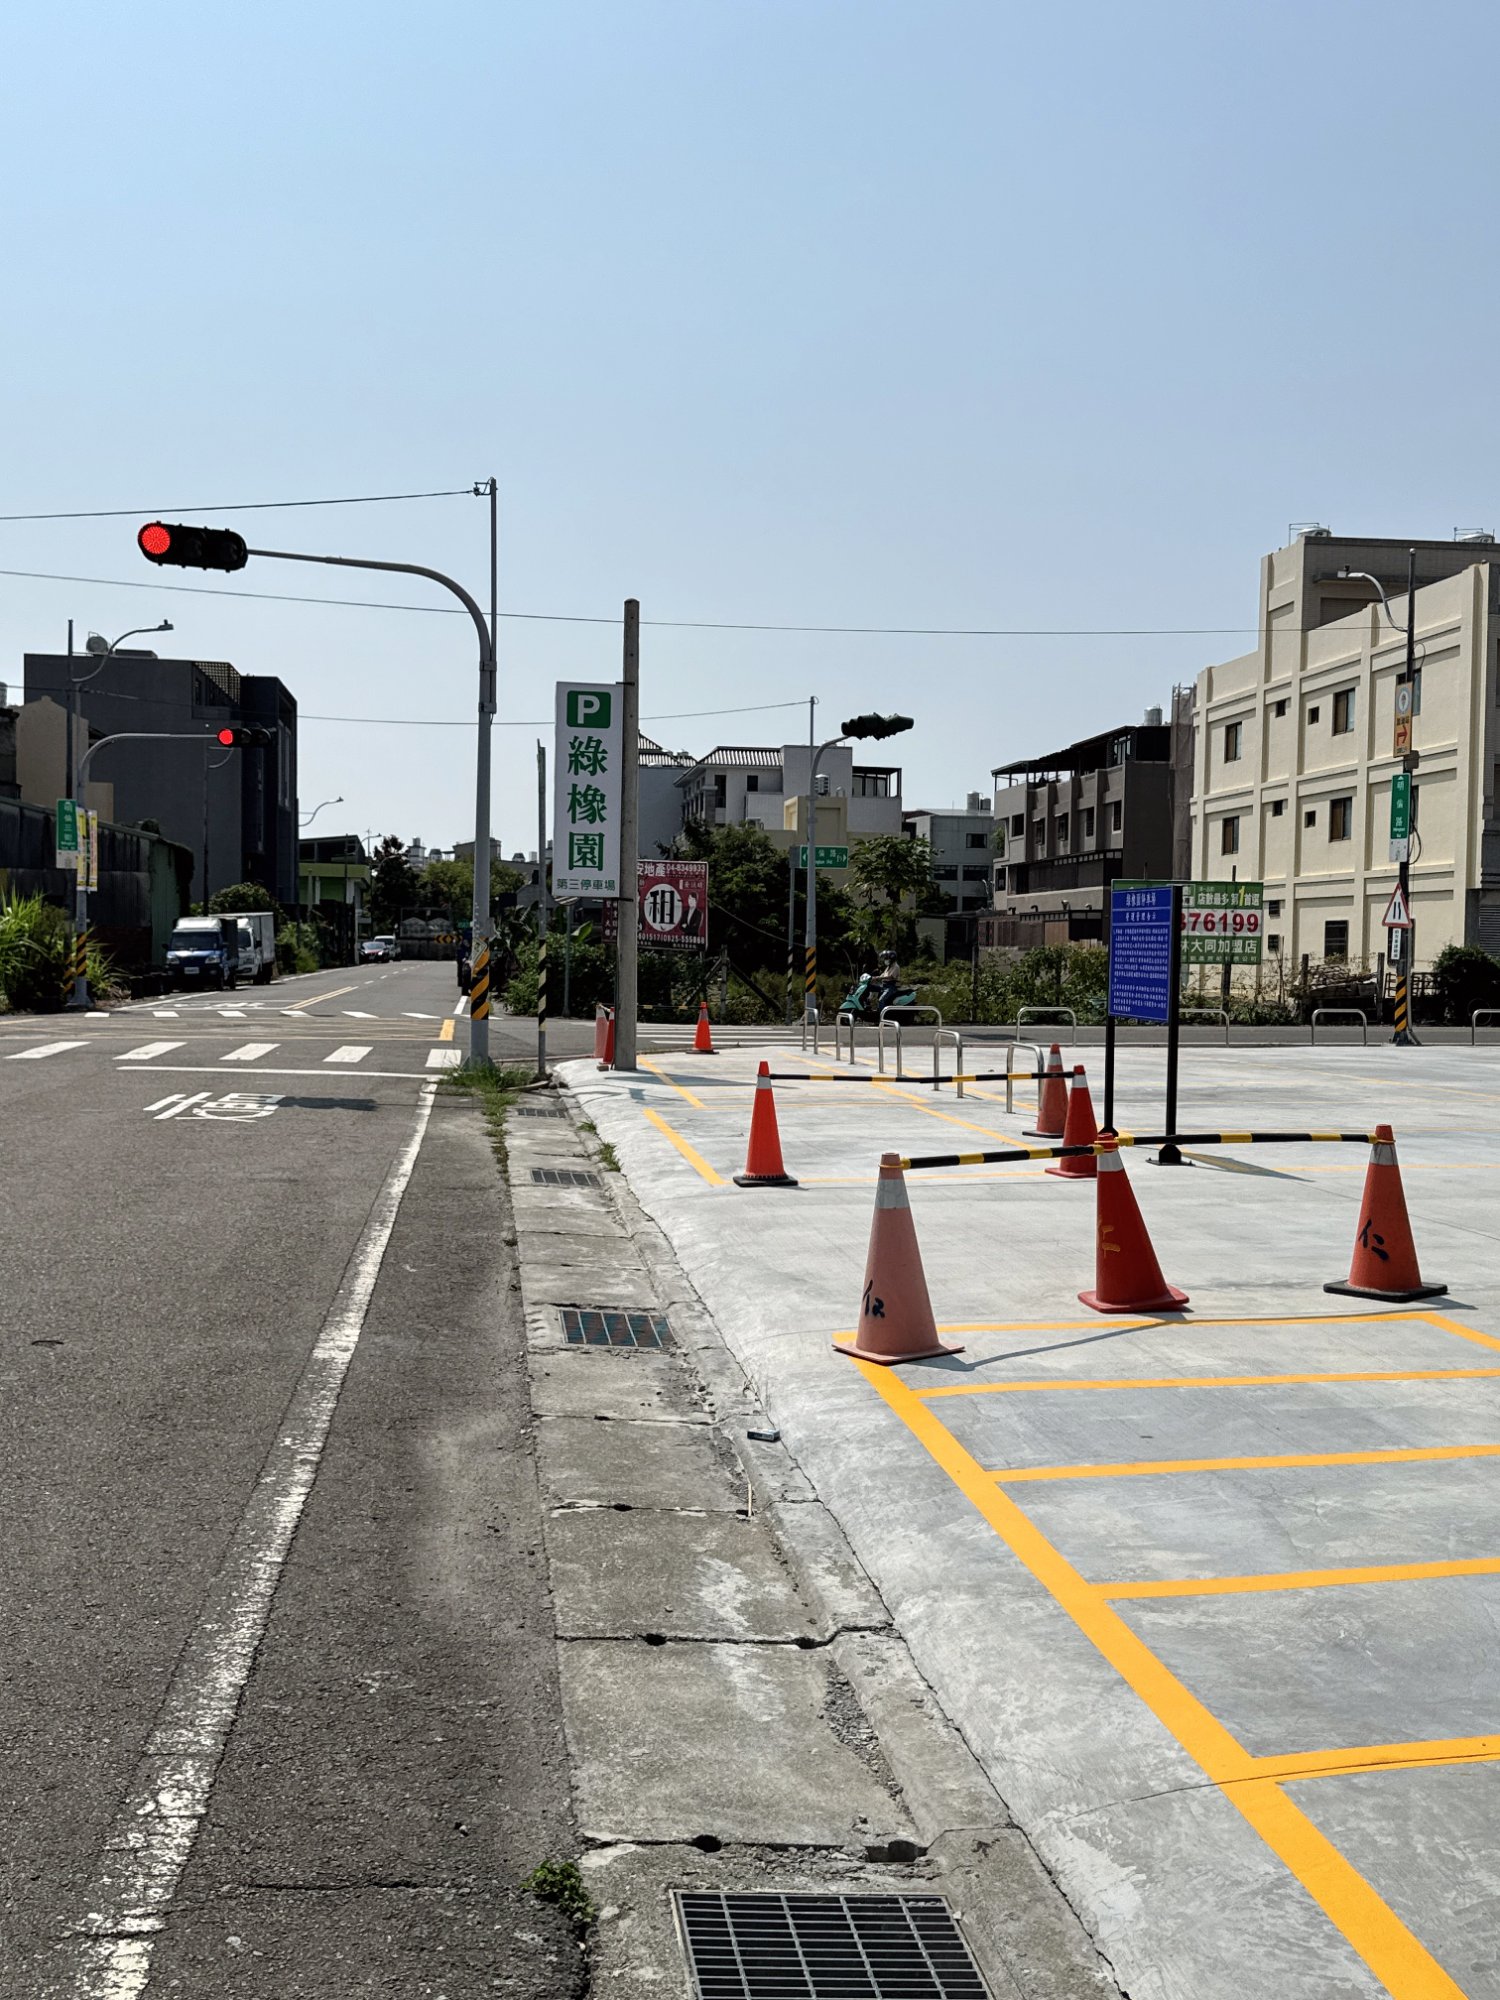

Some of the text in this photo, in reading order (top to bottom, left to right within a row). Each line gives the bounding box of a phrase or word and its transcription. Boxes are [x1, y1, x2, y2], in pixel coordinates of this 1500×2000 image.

[576, 694, 601, 725] P
[567, 735, 608, 871] 綠橡園
[556, 878, 616, 891] 第三停車場
[649, 889, 676, 925] 租
[143, 1091, 286, 1123] 慢
